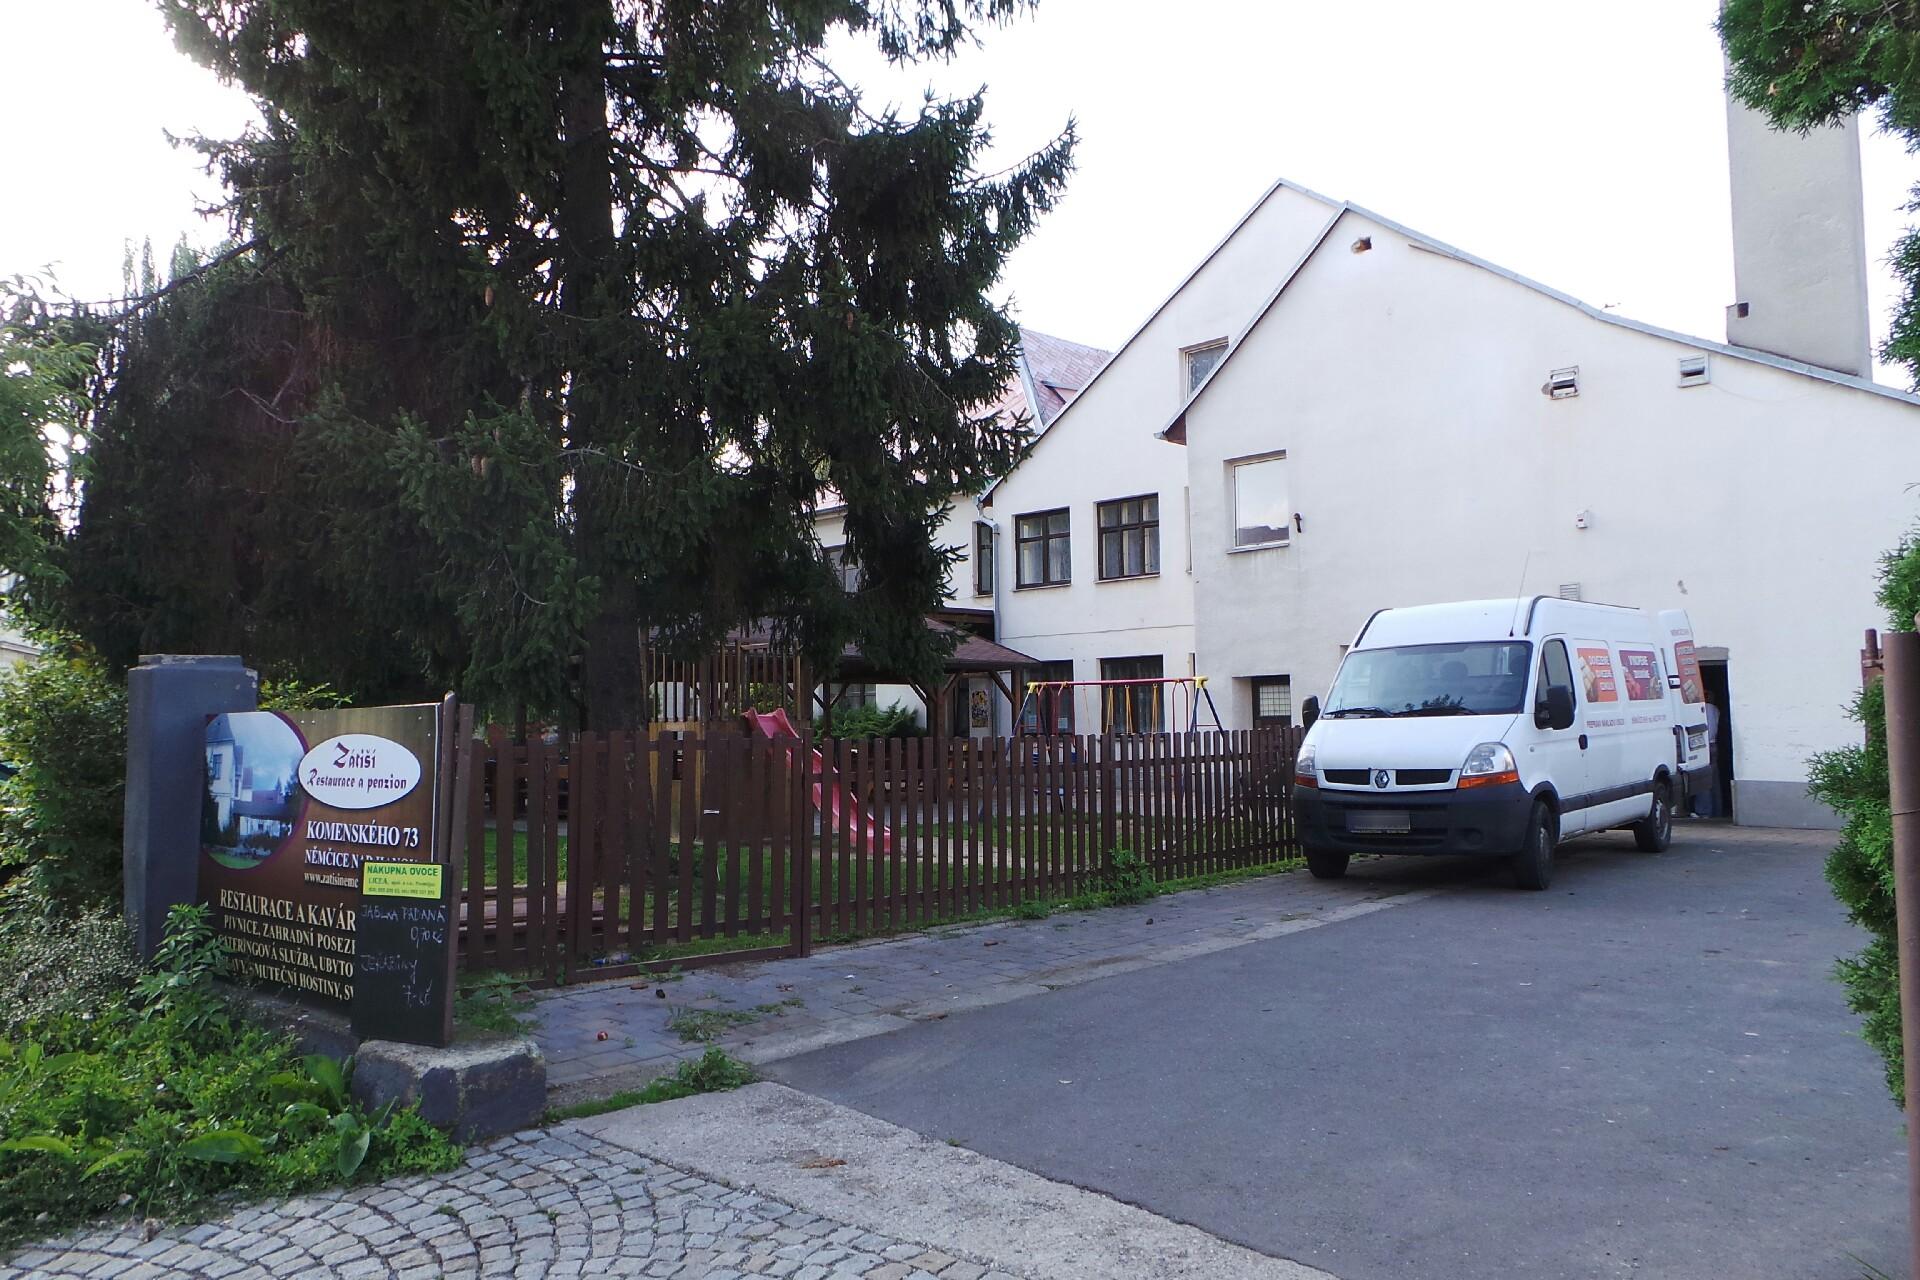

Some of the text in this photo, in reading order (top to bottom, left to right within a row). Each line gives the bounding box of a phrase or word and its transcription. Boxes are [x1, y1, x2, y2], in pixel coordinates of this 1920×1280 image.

[333, 742, 376, 769] Zátiší
[307, 768, 407, 792] Restaurace a penzion
[306, 819, 419, 847] KOMENSKÉHO 73
[304, 846, 350, 868] NĚMČICE
[409, 867, 438, 876] OVOCE
[220, 889, 293, 921] RESTAURACE
[296, 904, 305, 923] A
[224, 914, 261, 936] PIVNICE,
[263, 923, 314, 946] ZAHRADNÍ
[279, 947, 318, 971] SLUŽBA,
[319, 956, 353, 978] UBYTO
[252, 962, 297, 986] MUTEČNÍ
[299, 973, 342, 1000] HOSTINY,
